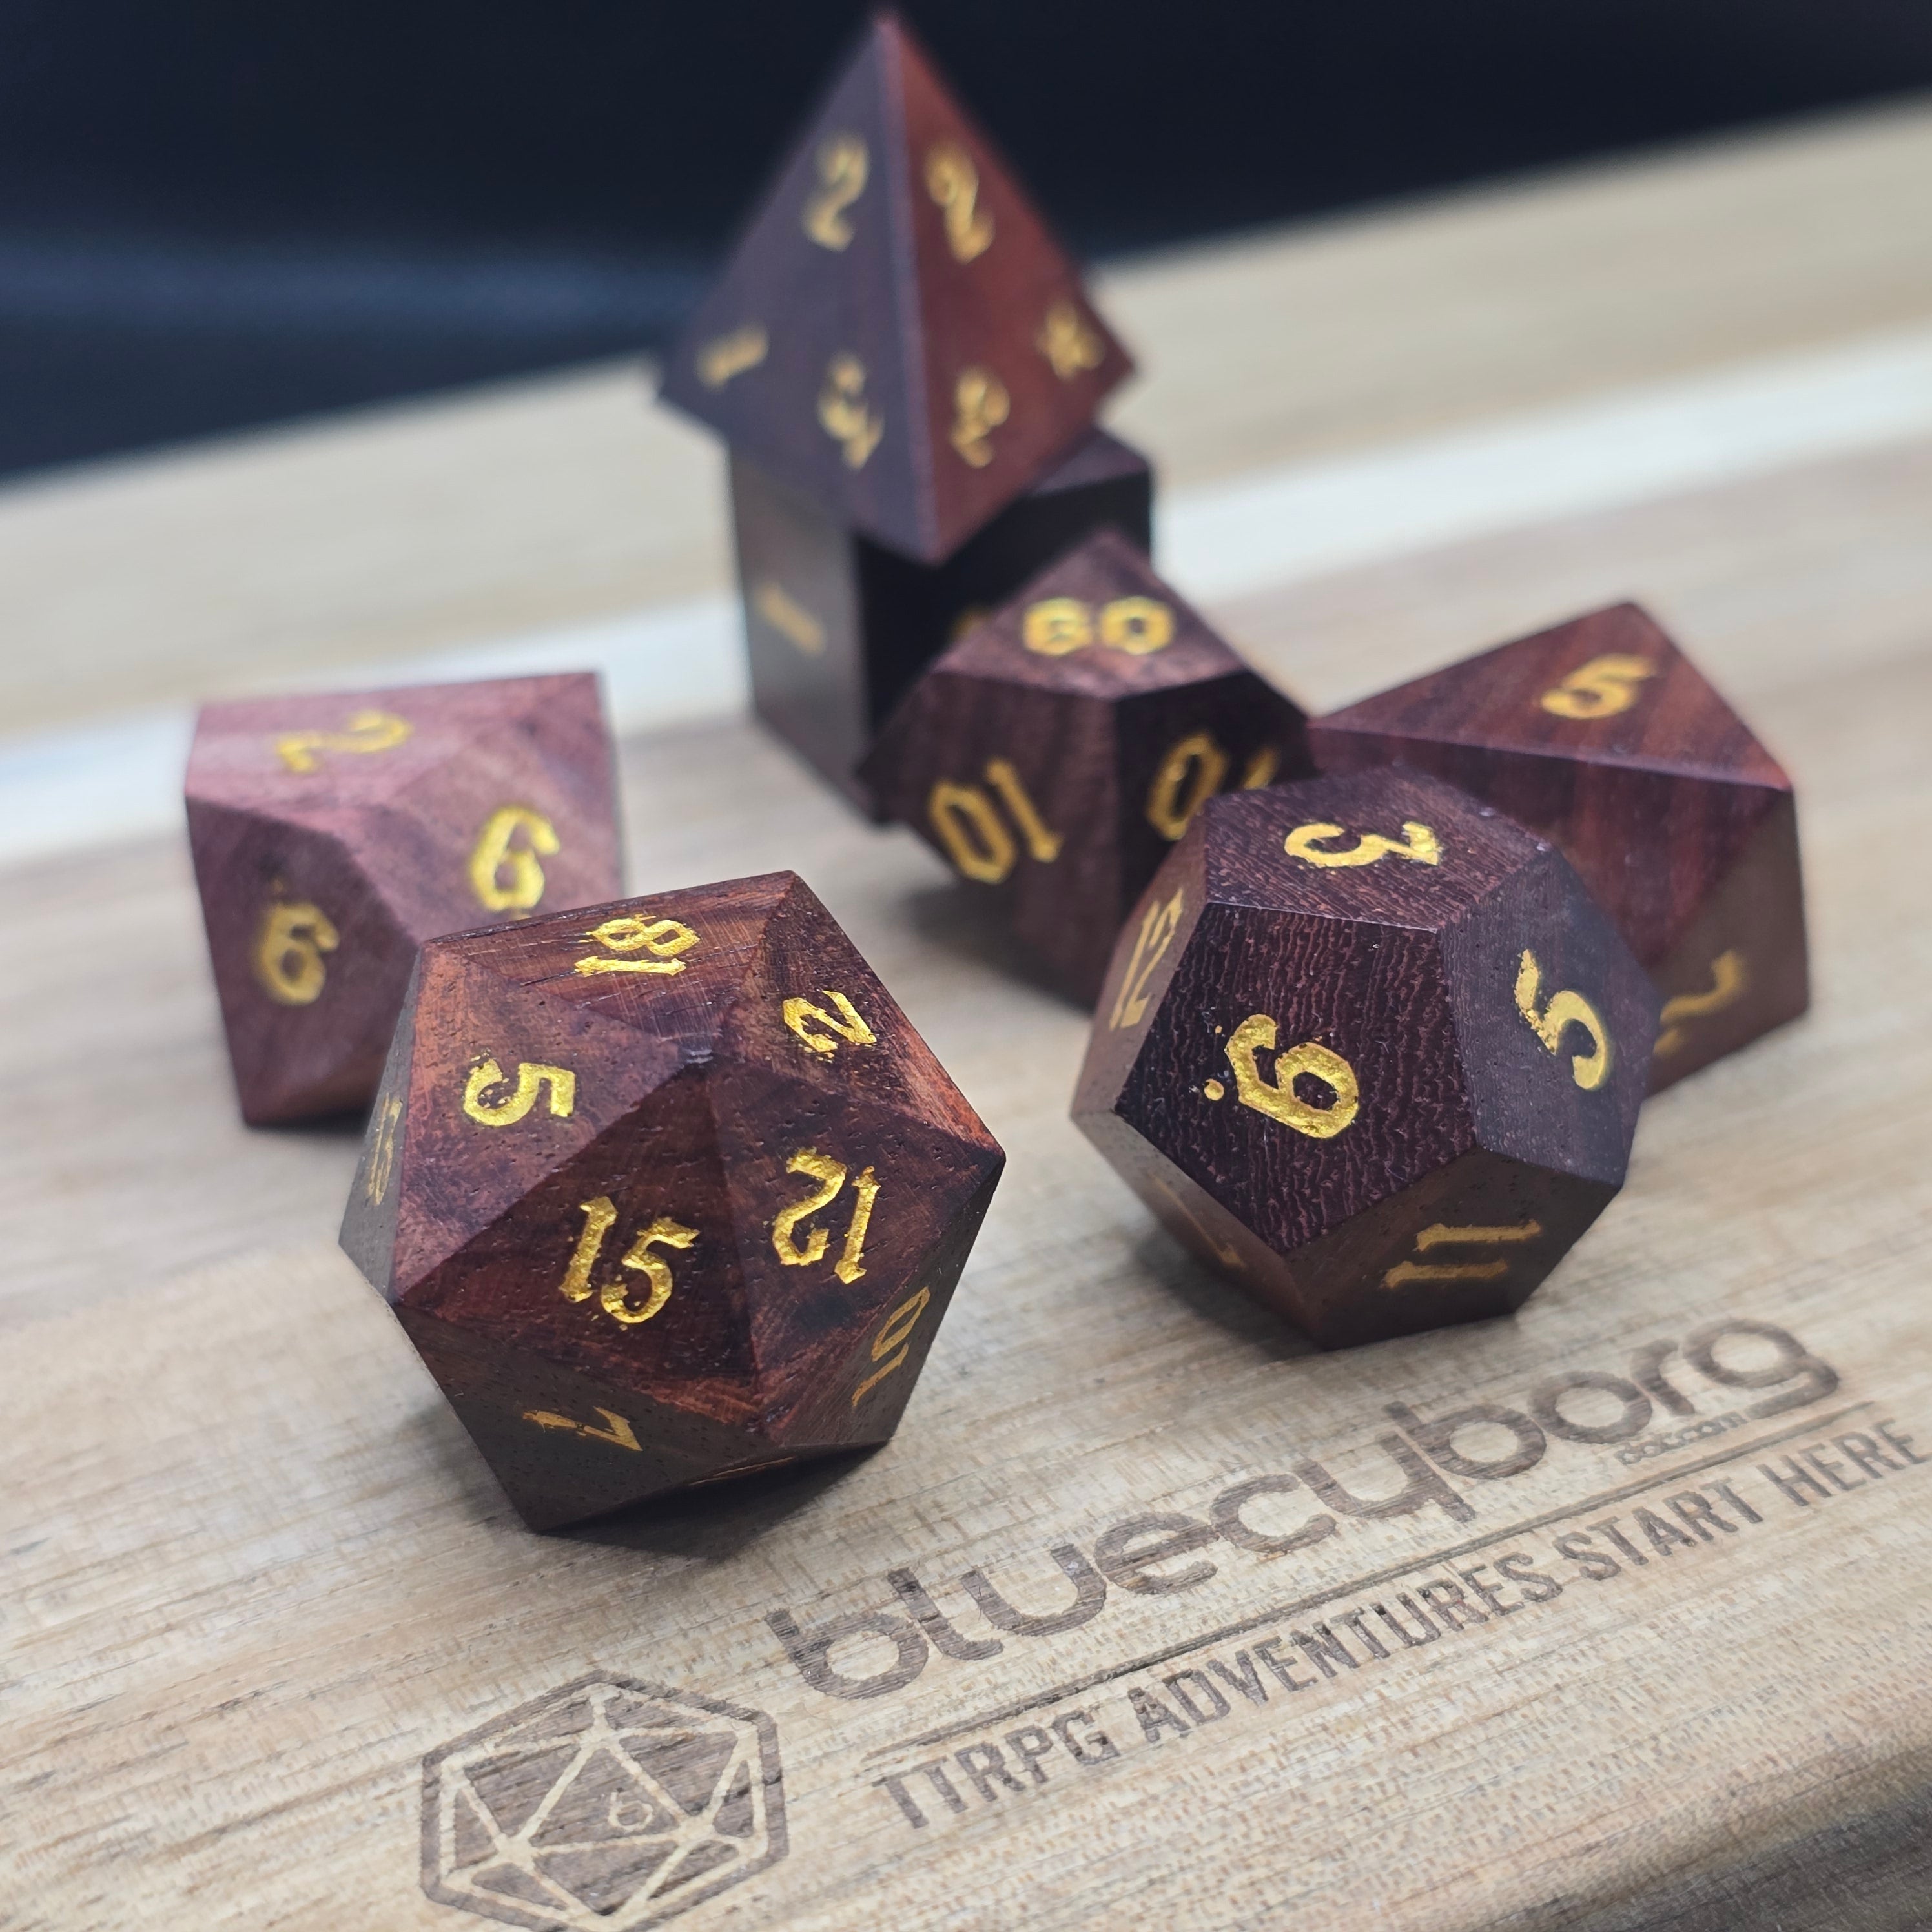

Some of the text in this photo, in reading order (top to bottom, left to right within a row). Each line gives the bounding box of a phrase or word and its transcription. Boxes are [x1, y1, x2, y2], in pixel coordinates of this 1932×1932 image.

[804, 137, 868, 250] 2
[1284, 821, 1441, 868] 3
[575, 912, 701, 978] 18
[1108, 887, 1184, 1032] 12
[1514, 949, 1610, 1091] 5
[462, 1058, 575, 1127] 5
[557, 1195, 699, 1326] 15
[851, 1286, 930, 1408] 10
[766, 1318, 1842, 1701] bluecyborg
[872, 1417, 1932, 1829] TTRPG ADVENTURES START HERE
